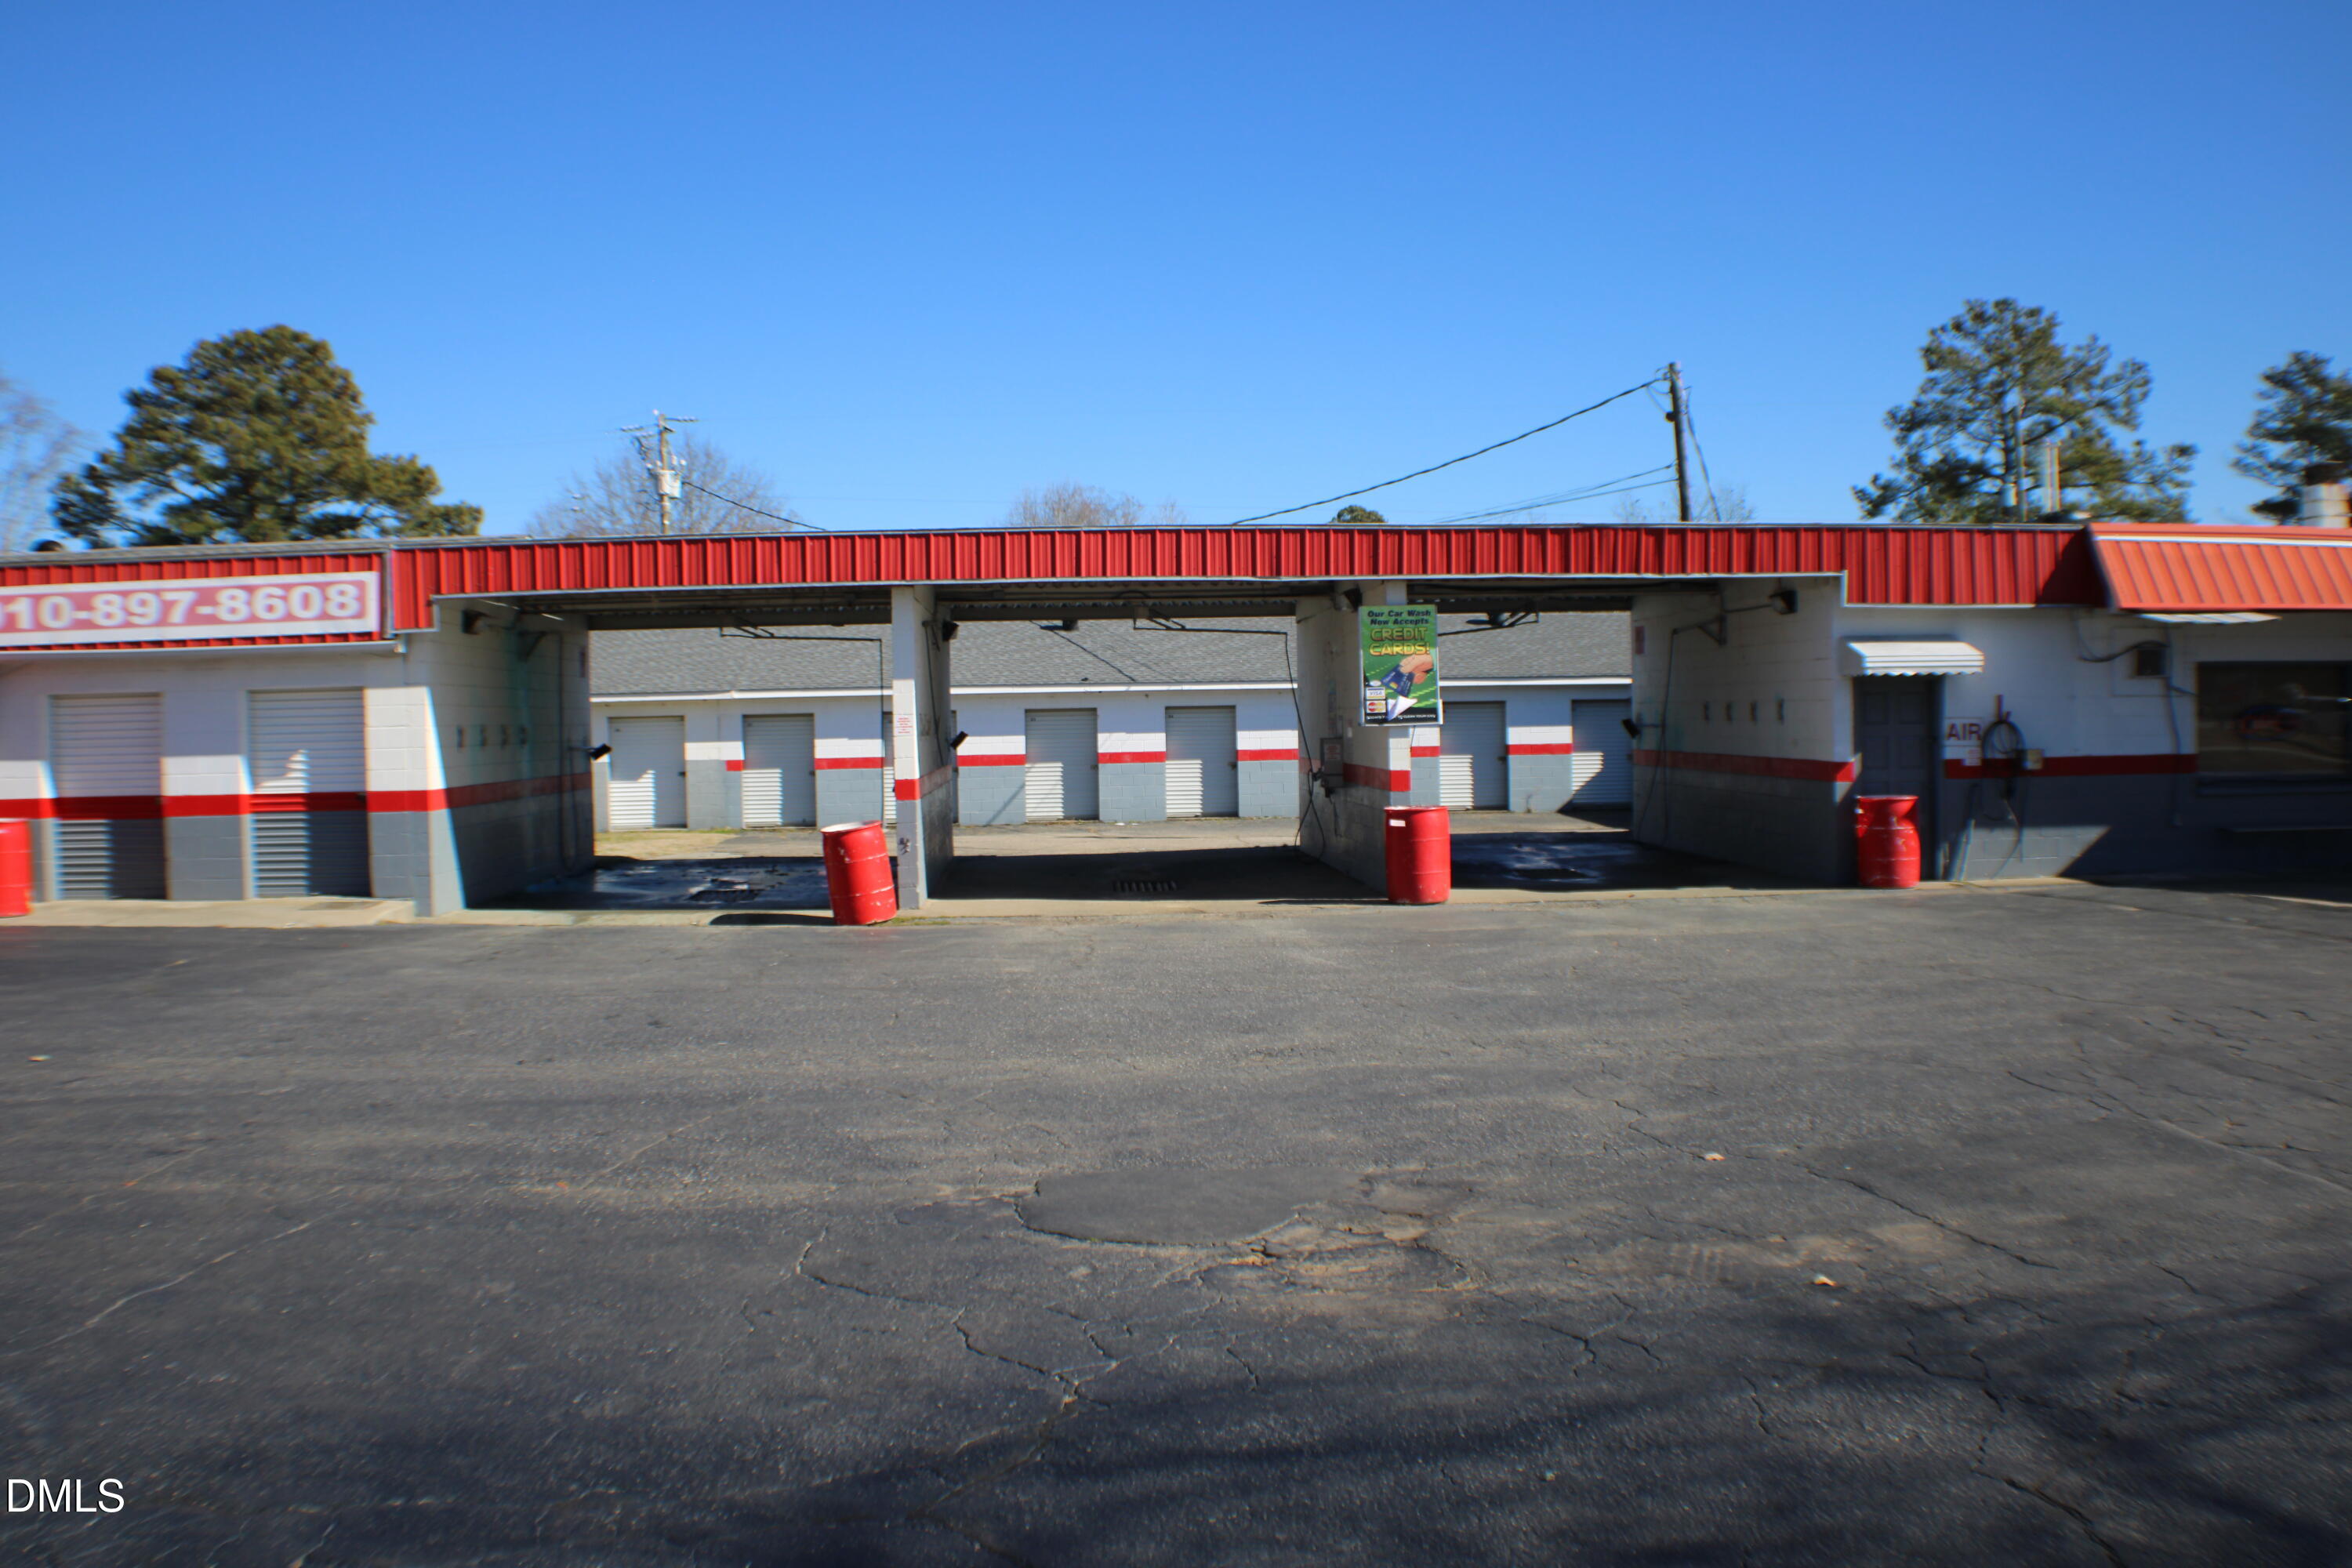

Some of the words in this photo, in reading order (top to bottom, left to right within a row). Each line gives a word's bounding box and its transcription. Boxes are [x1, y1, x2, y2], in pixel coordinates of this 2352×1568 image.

[0, 583, 361, 630] 10-897-8608
[1371, 627, 1428, 641] CREDIT
[1370, 642, 1430, 656] CARDS!
[1946, 723, 1982, 741] AIR
